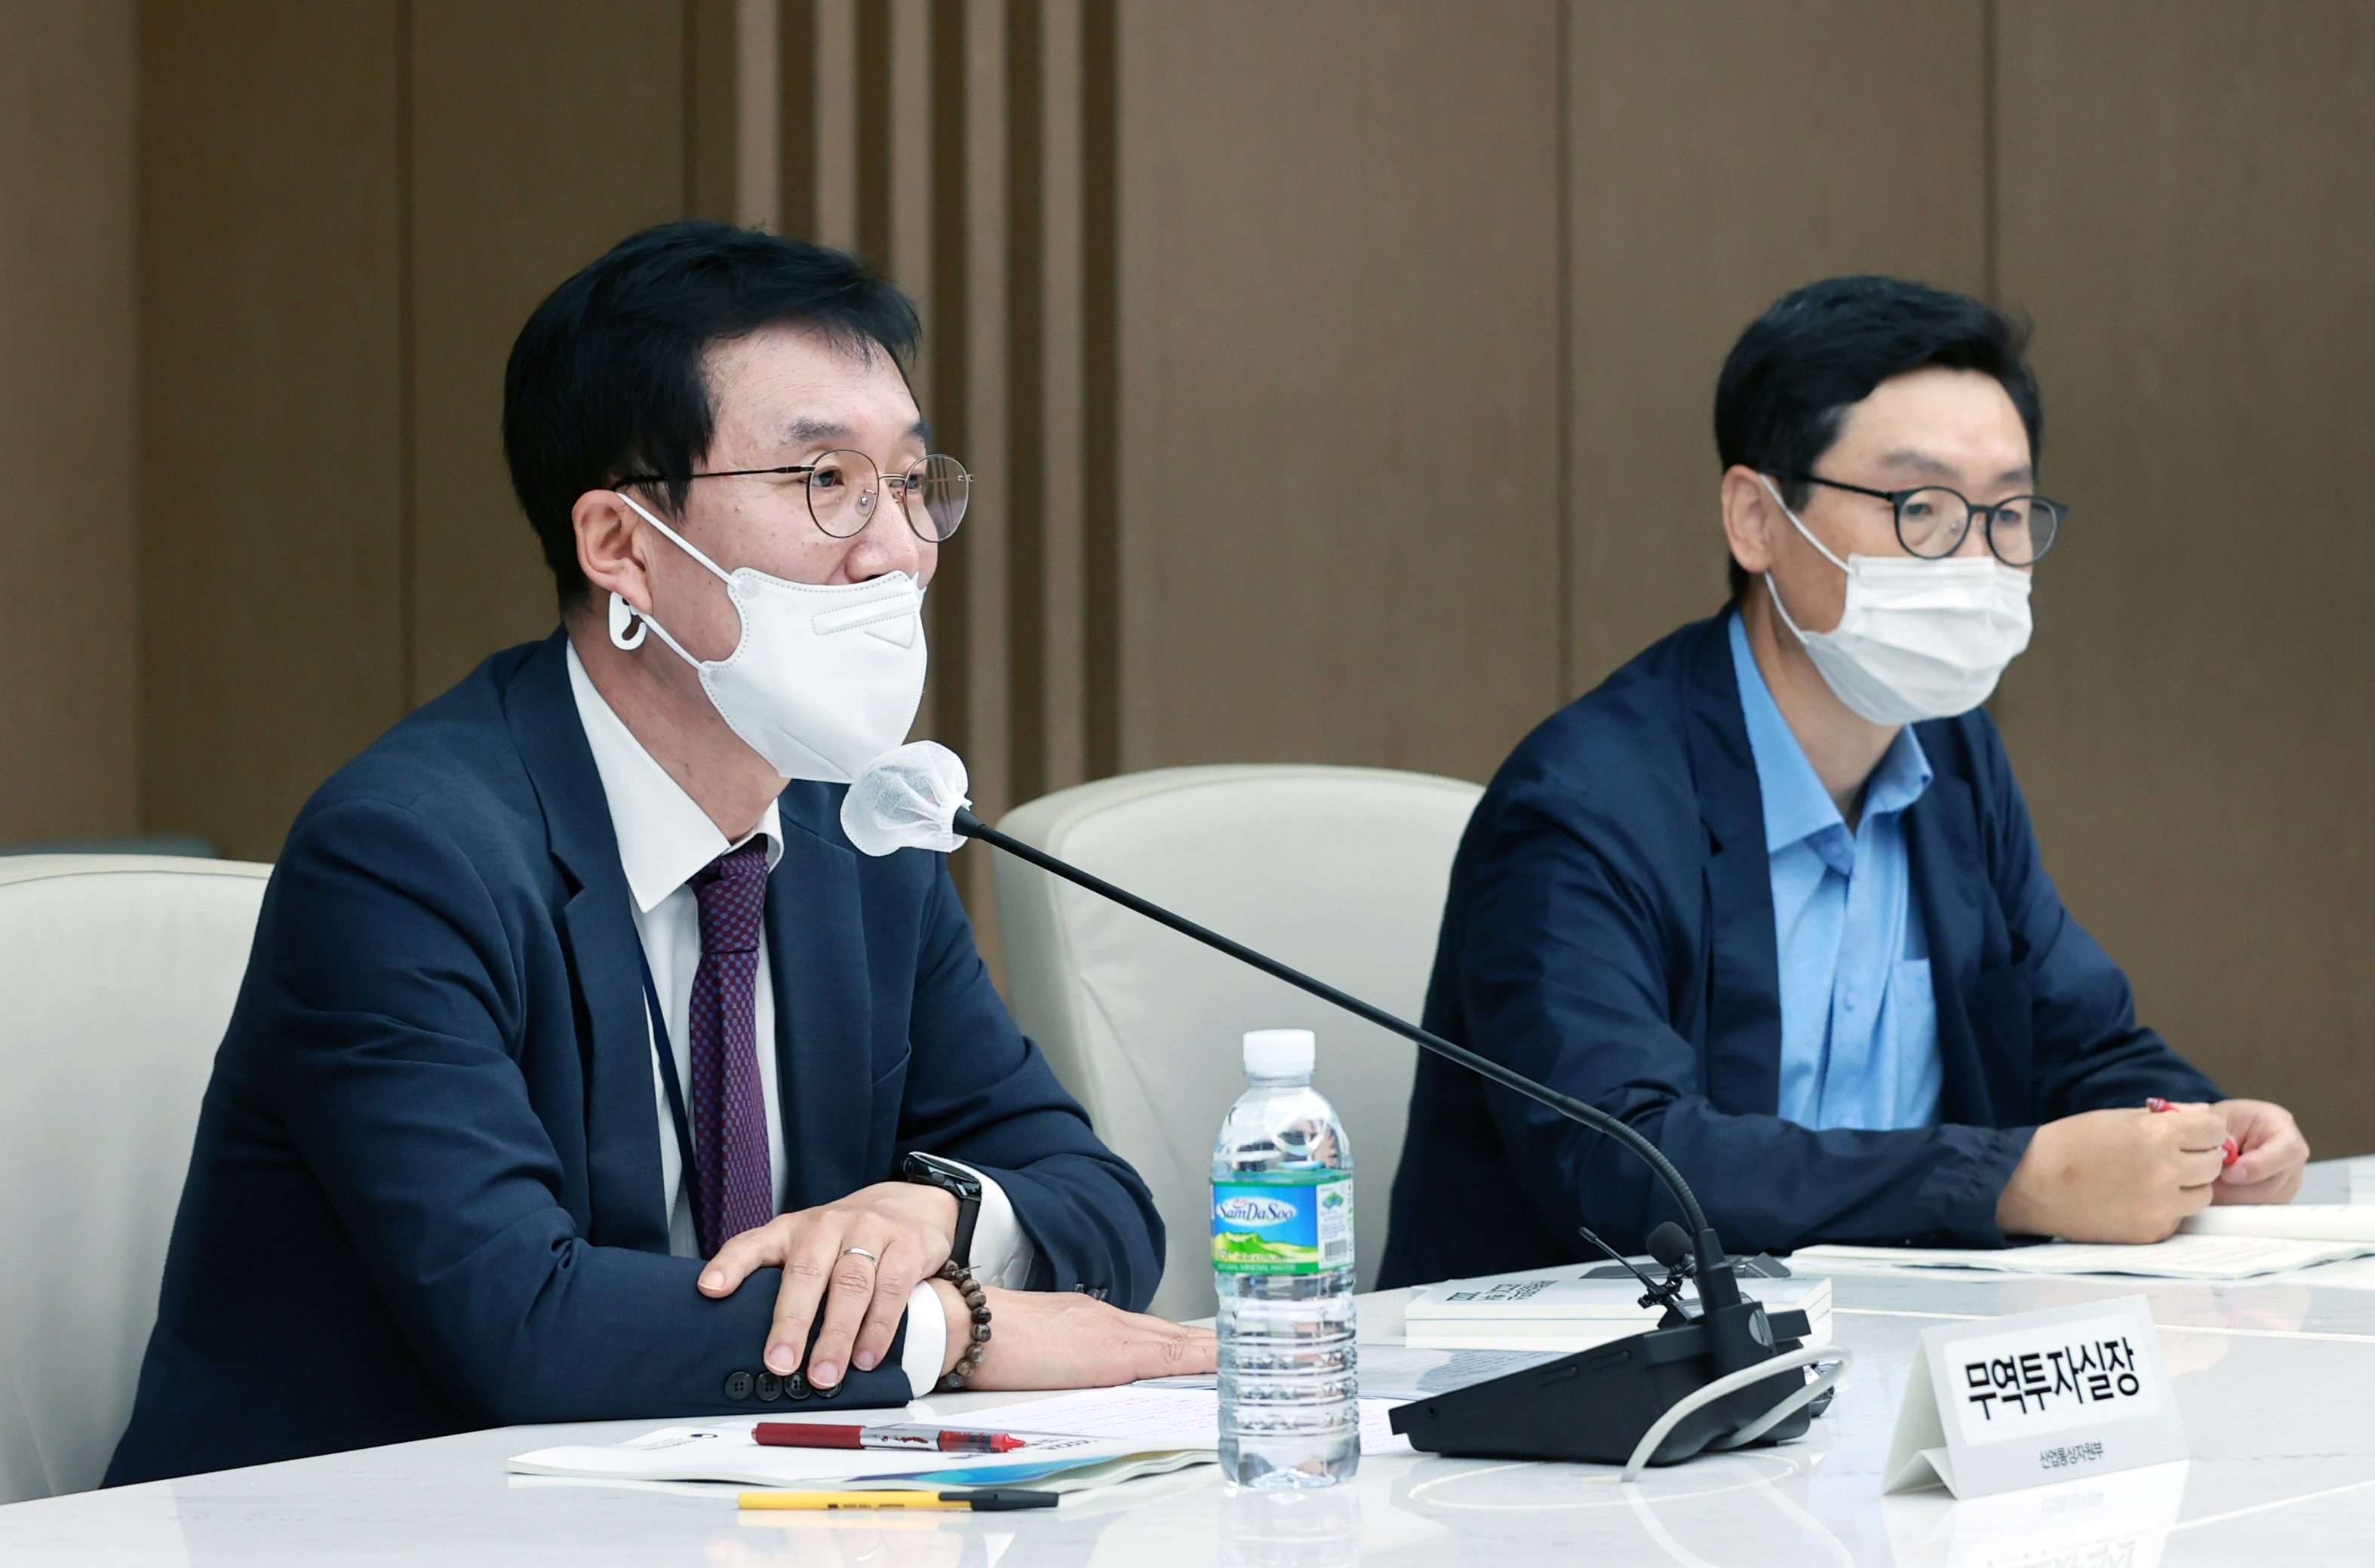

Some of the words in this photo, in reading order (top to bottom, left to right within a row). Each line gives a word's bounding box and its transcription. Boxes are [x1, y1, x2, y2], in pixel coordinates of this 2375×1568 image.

[1219, 1202, 1293, 1220] SamDaSoo
[1965, 1336, 2140, 1420] 무역투자실장
[2040, 1441, 2103, 1469] 산업통상자원부
